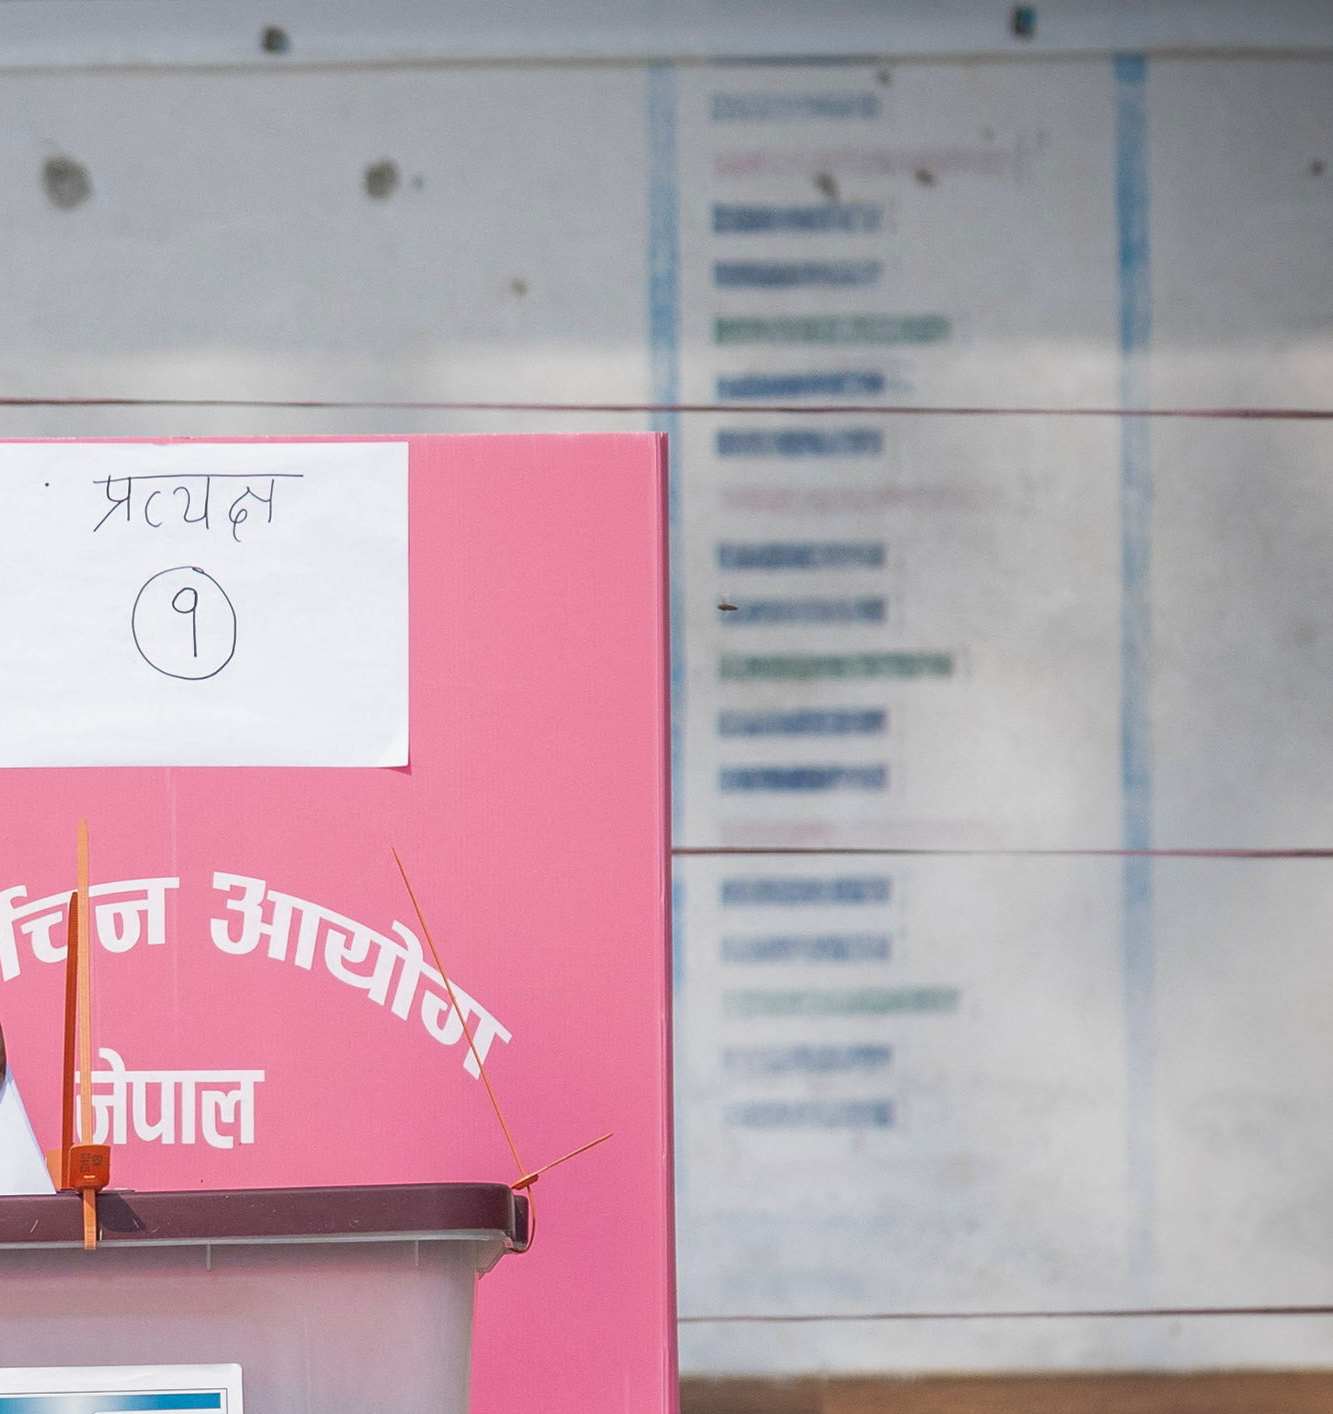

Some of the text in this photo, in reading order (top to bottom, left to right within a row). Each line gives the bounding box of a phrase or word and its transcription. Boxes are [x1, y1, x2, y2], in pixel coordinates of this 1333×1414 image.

[93, 473, 304, 543] प्रत्यक्ष
[210, 870, 513, 1080] आयोग
[75, 1047, 265, 1150] नेपाल
